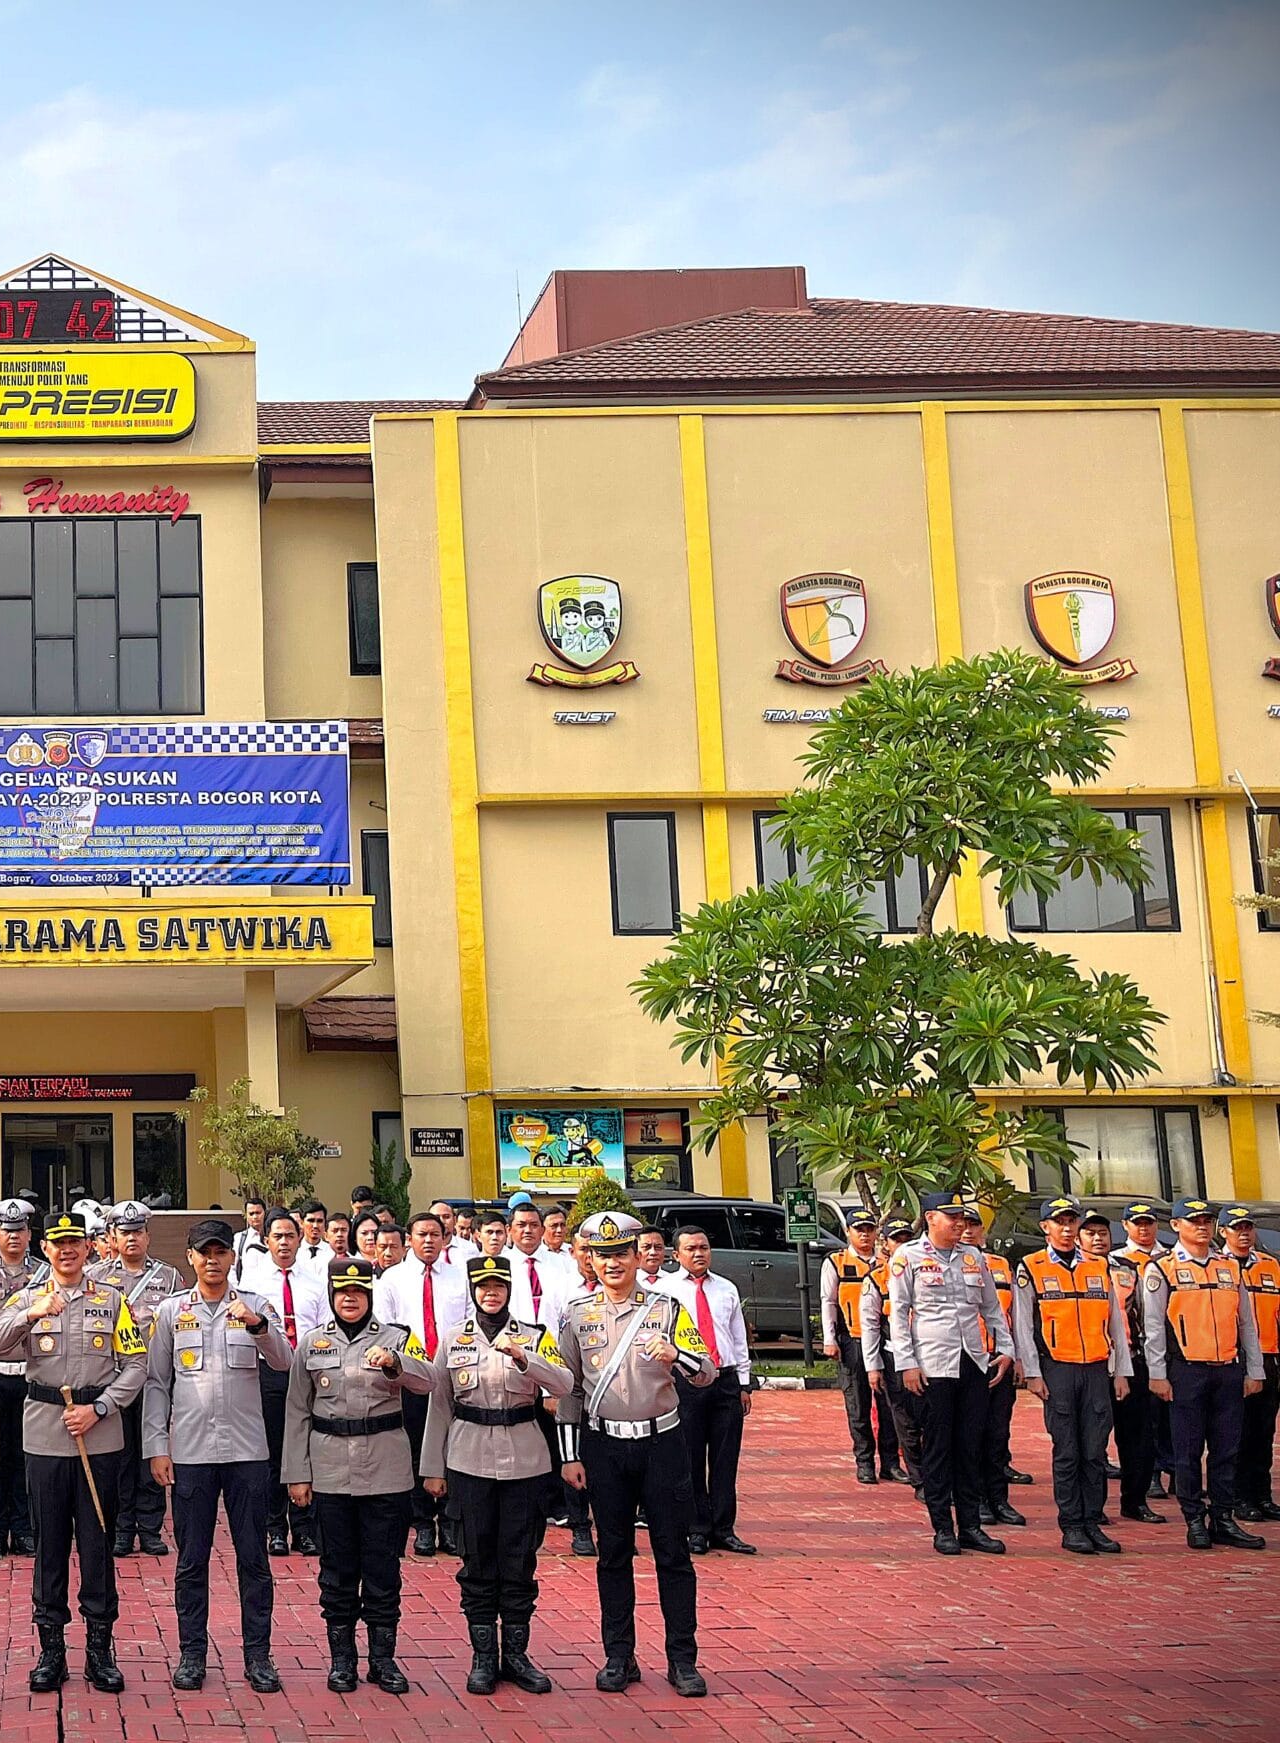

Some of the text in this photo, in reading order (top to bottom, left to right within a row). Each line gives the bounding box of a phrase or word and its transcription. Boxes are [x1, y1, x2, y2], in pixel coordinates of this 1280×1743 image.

[67, 300, 115, 338] 42
[0, 361, 66, 372] TRANSFORMASI
[0, 374, 88, 386] MENUJU POLRI YANG
[0, 388, 178, 415] PRESISI
[23, 477, 190, 525] Humanity
[787, 579, 818, 593] POLRESTA
[1034, 578, 1066, 592] POLRESTA
[554, 712, 616, 724] TRUST
[765, 710, 796, 722] TIM
[0, 772, 69, 787] GELAR
[76, 771, 177, 786] PASUKAN
[96, 792, 193, 806] POLRESTA
[198, 791, 265, 805] BOGOR
[270, 790, 322, 804] KOTA
[0, 873, 119, 884] Bogor, Oktober 2024
[137, 916, 332, 951] SATWIKA
[31, 1078, 89, 1089] TERPADU
[516, 1127, 541, 1137] Drive
[527, 1168, 593, 1178] SKCK
[84, 1308, 113, 1318] POLRI
[580, 1324, 598, 1333] RUDY
